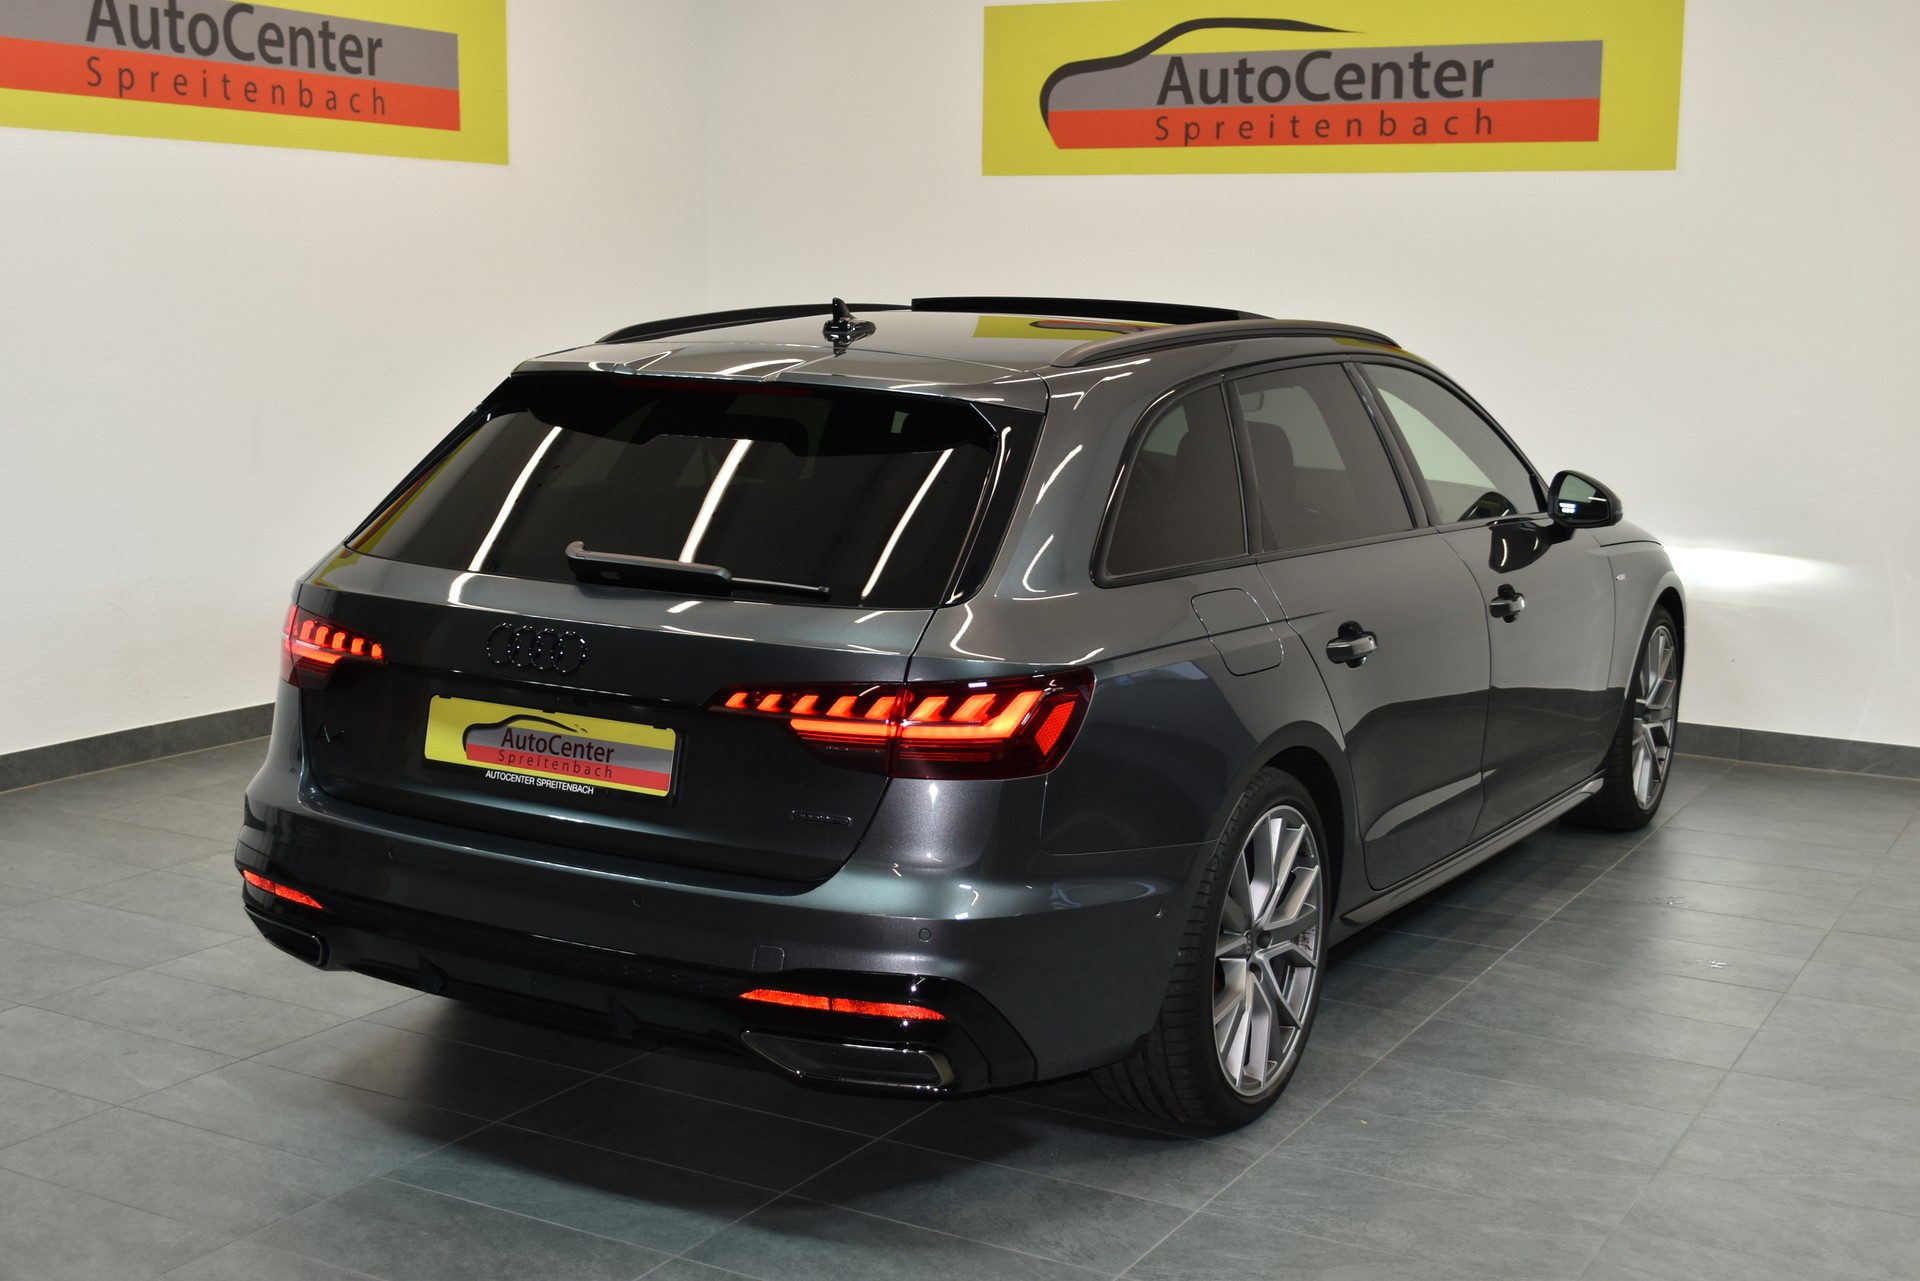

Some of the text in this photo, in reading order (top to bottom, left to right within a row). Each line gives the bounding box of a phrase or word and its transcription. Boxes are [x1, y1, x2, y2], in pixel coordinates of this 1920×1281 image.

[86, 0, 383, 76] AutoCenter
[86, 56, 386, 115] Spreitenbach
[1156, 50, 1494, 105] AutoCenter
[1155, 108, 1493, 147] Spreitenbach
[498, 750, 612, 778] Spreitenbach
[501, 728, 615, 764] AutoCenter
[485, 770, 594, 795] AUTOCENTER SPREITENBACH
